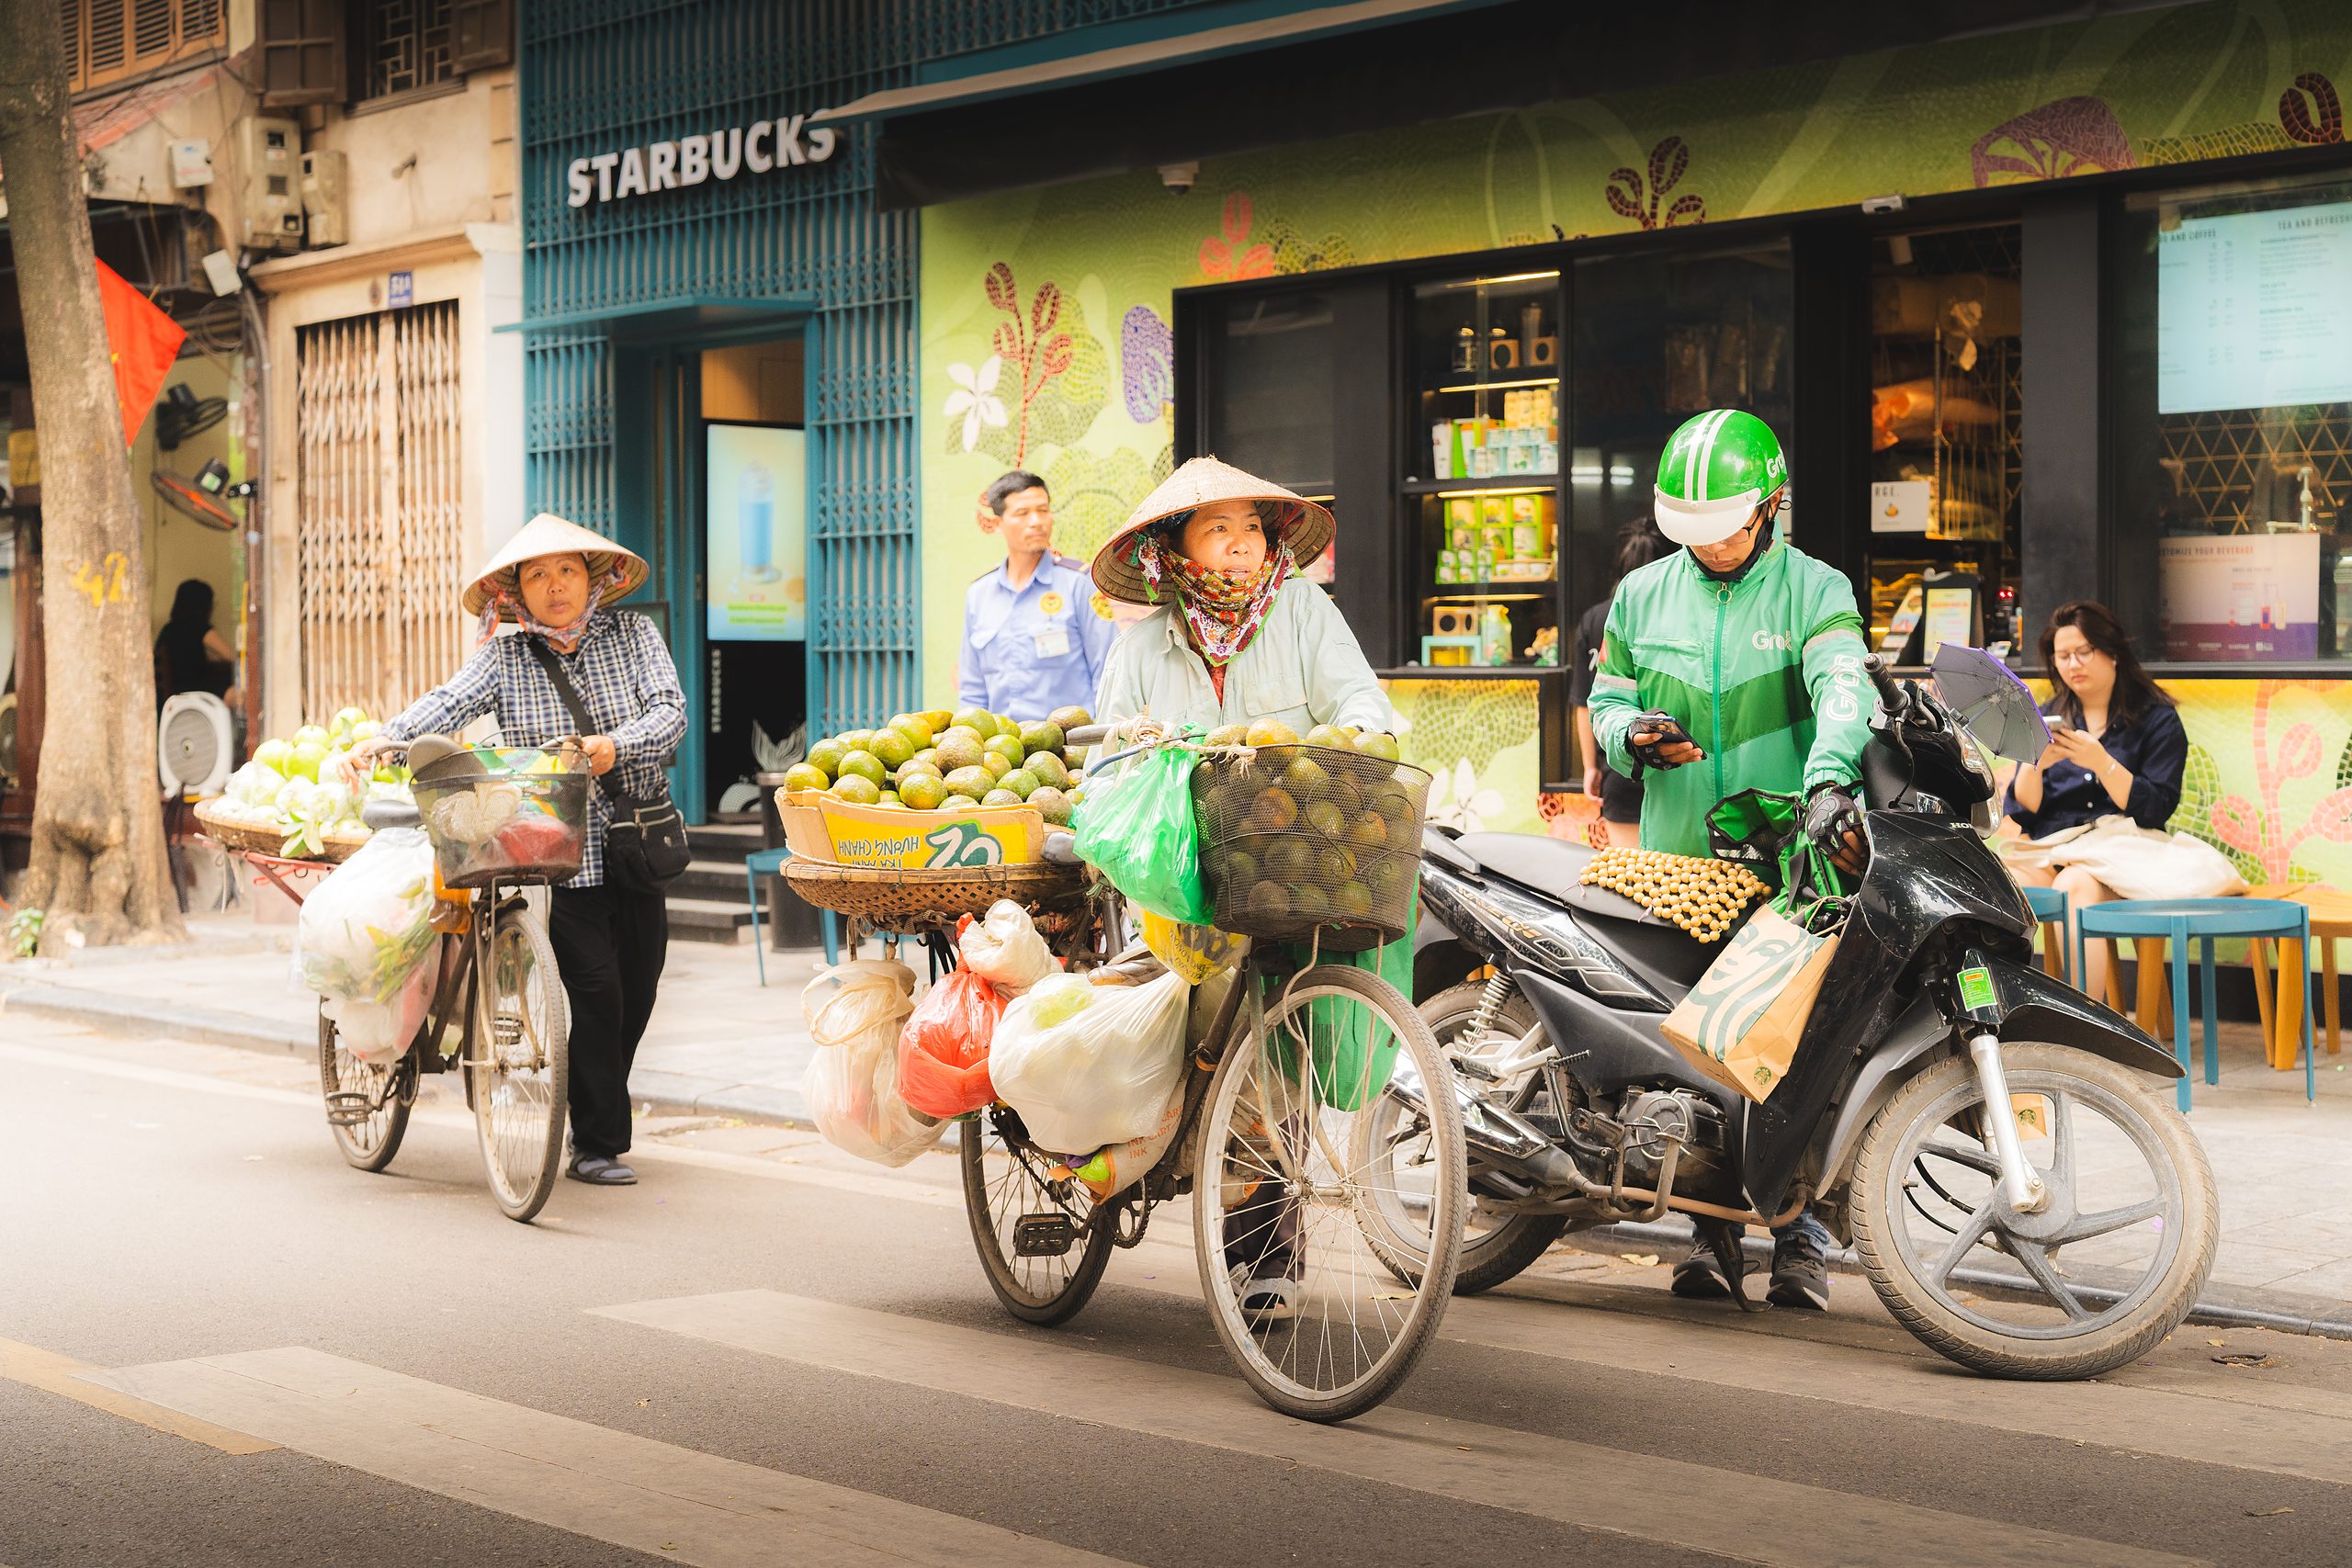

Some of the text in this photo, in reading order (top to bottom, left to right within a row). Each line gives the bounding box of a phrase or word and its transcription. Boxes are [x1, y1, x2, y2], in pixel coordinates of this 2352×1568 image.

[567, 108, 836, 209] STARBUCKS
[1826, 654, 1860, 722] Grab
[837, 838, 872, 857] CHANH
[1129, 1146, 1148, 1159] INK
